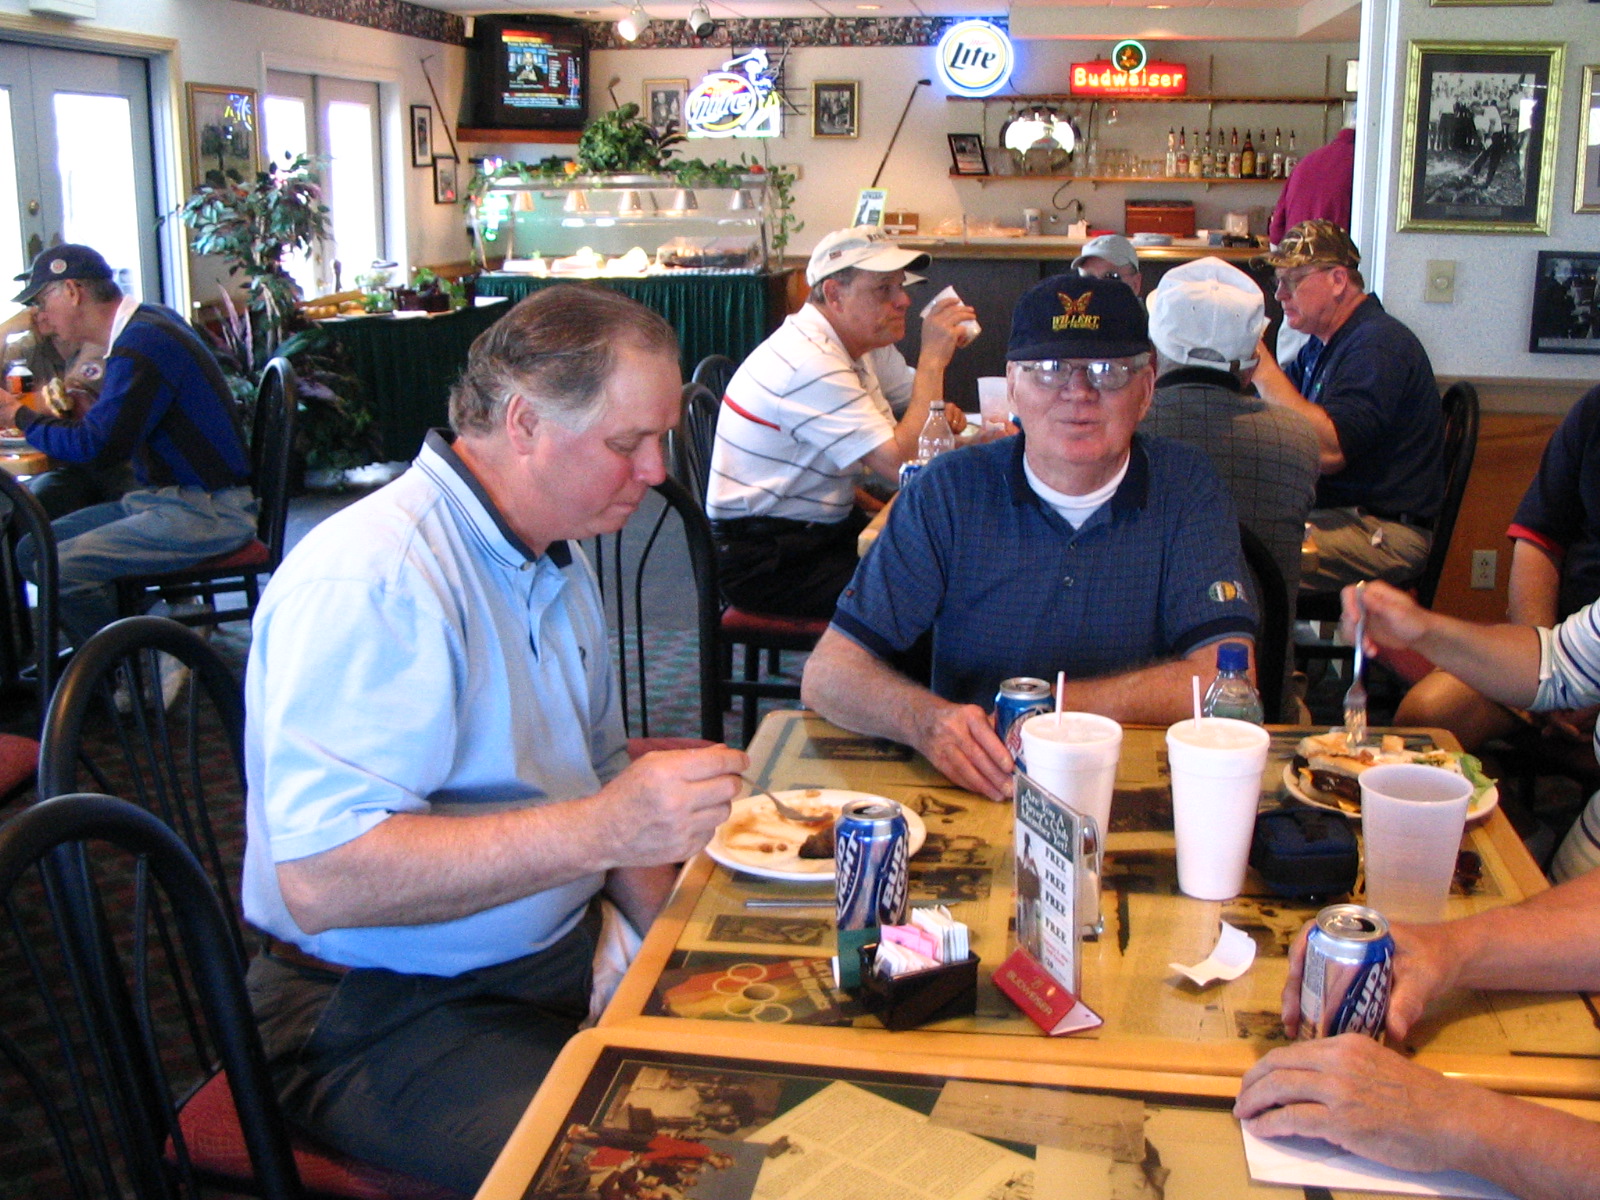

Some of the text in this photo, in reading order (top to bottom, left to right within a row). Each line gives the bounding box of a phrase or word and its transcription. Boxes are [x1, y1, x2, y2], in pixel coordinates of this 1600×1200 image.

[949, 42, 996, 70] Lite
[1073, 67, 1183, 87] Budweiser
[1052, 315, 1100, 325] WILLERT
[1025, 789, 1065, 829] Are You A
[1050, 818, 1069, 841] Club
[881, 835, 903, 909] BUD
[1045, 846, 1067, 873] FREE
[1045, 868, 1067, 895] FREE
[1045, 890, 1067, 917] FREE
[1045, 917, 1067, 944] FREE
[1345, 963, 1380, 1034] BUD
